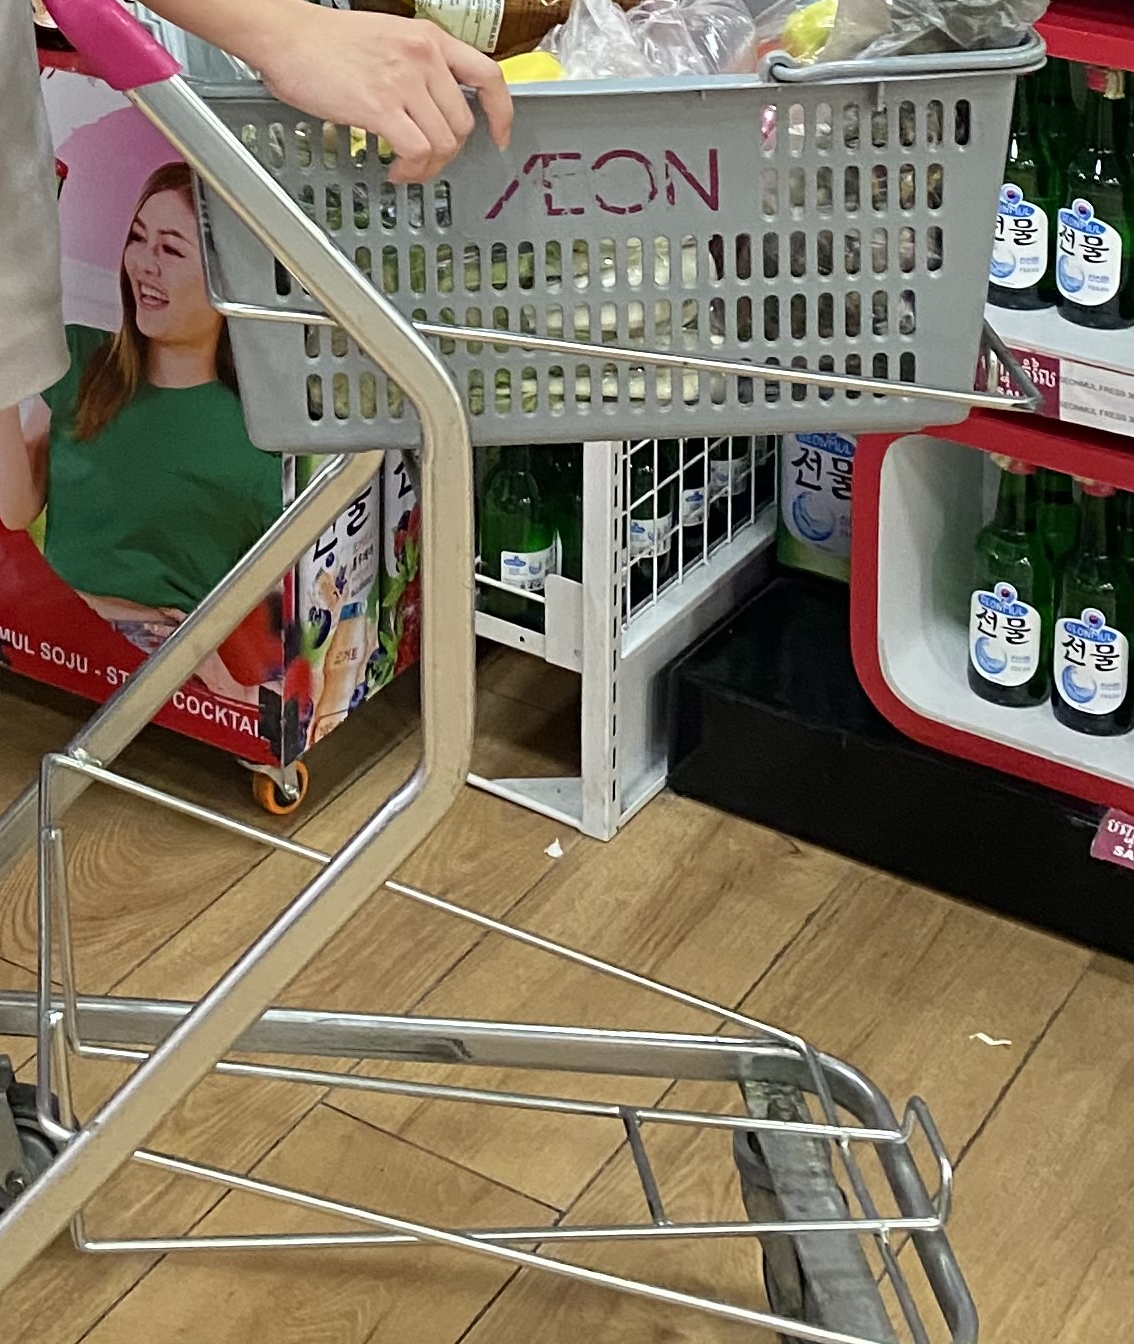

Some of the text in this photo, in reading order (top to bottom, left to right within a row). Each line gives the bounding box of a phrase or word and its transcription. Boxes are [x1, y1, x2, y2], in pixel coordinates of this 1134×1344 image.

[1058, 224, 1110, 264] 선물
[792, 448, 852, 499] 선물
[976, 608, 1032, 645] 선물
[40, 642, 87, 674] SOJU
[1063, 634, 1119, 672] 선물
